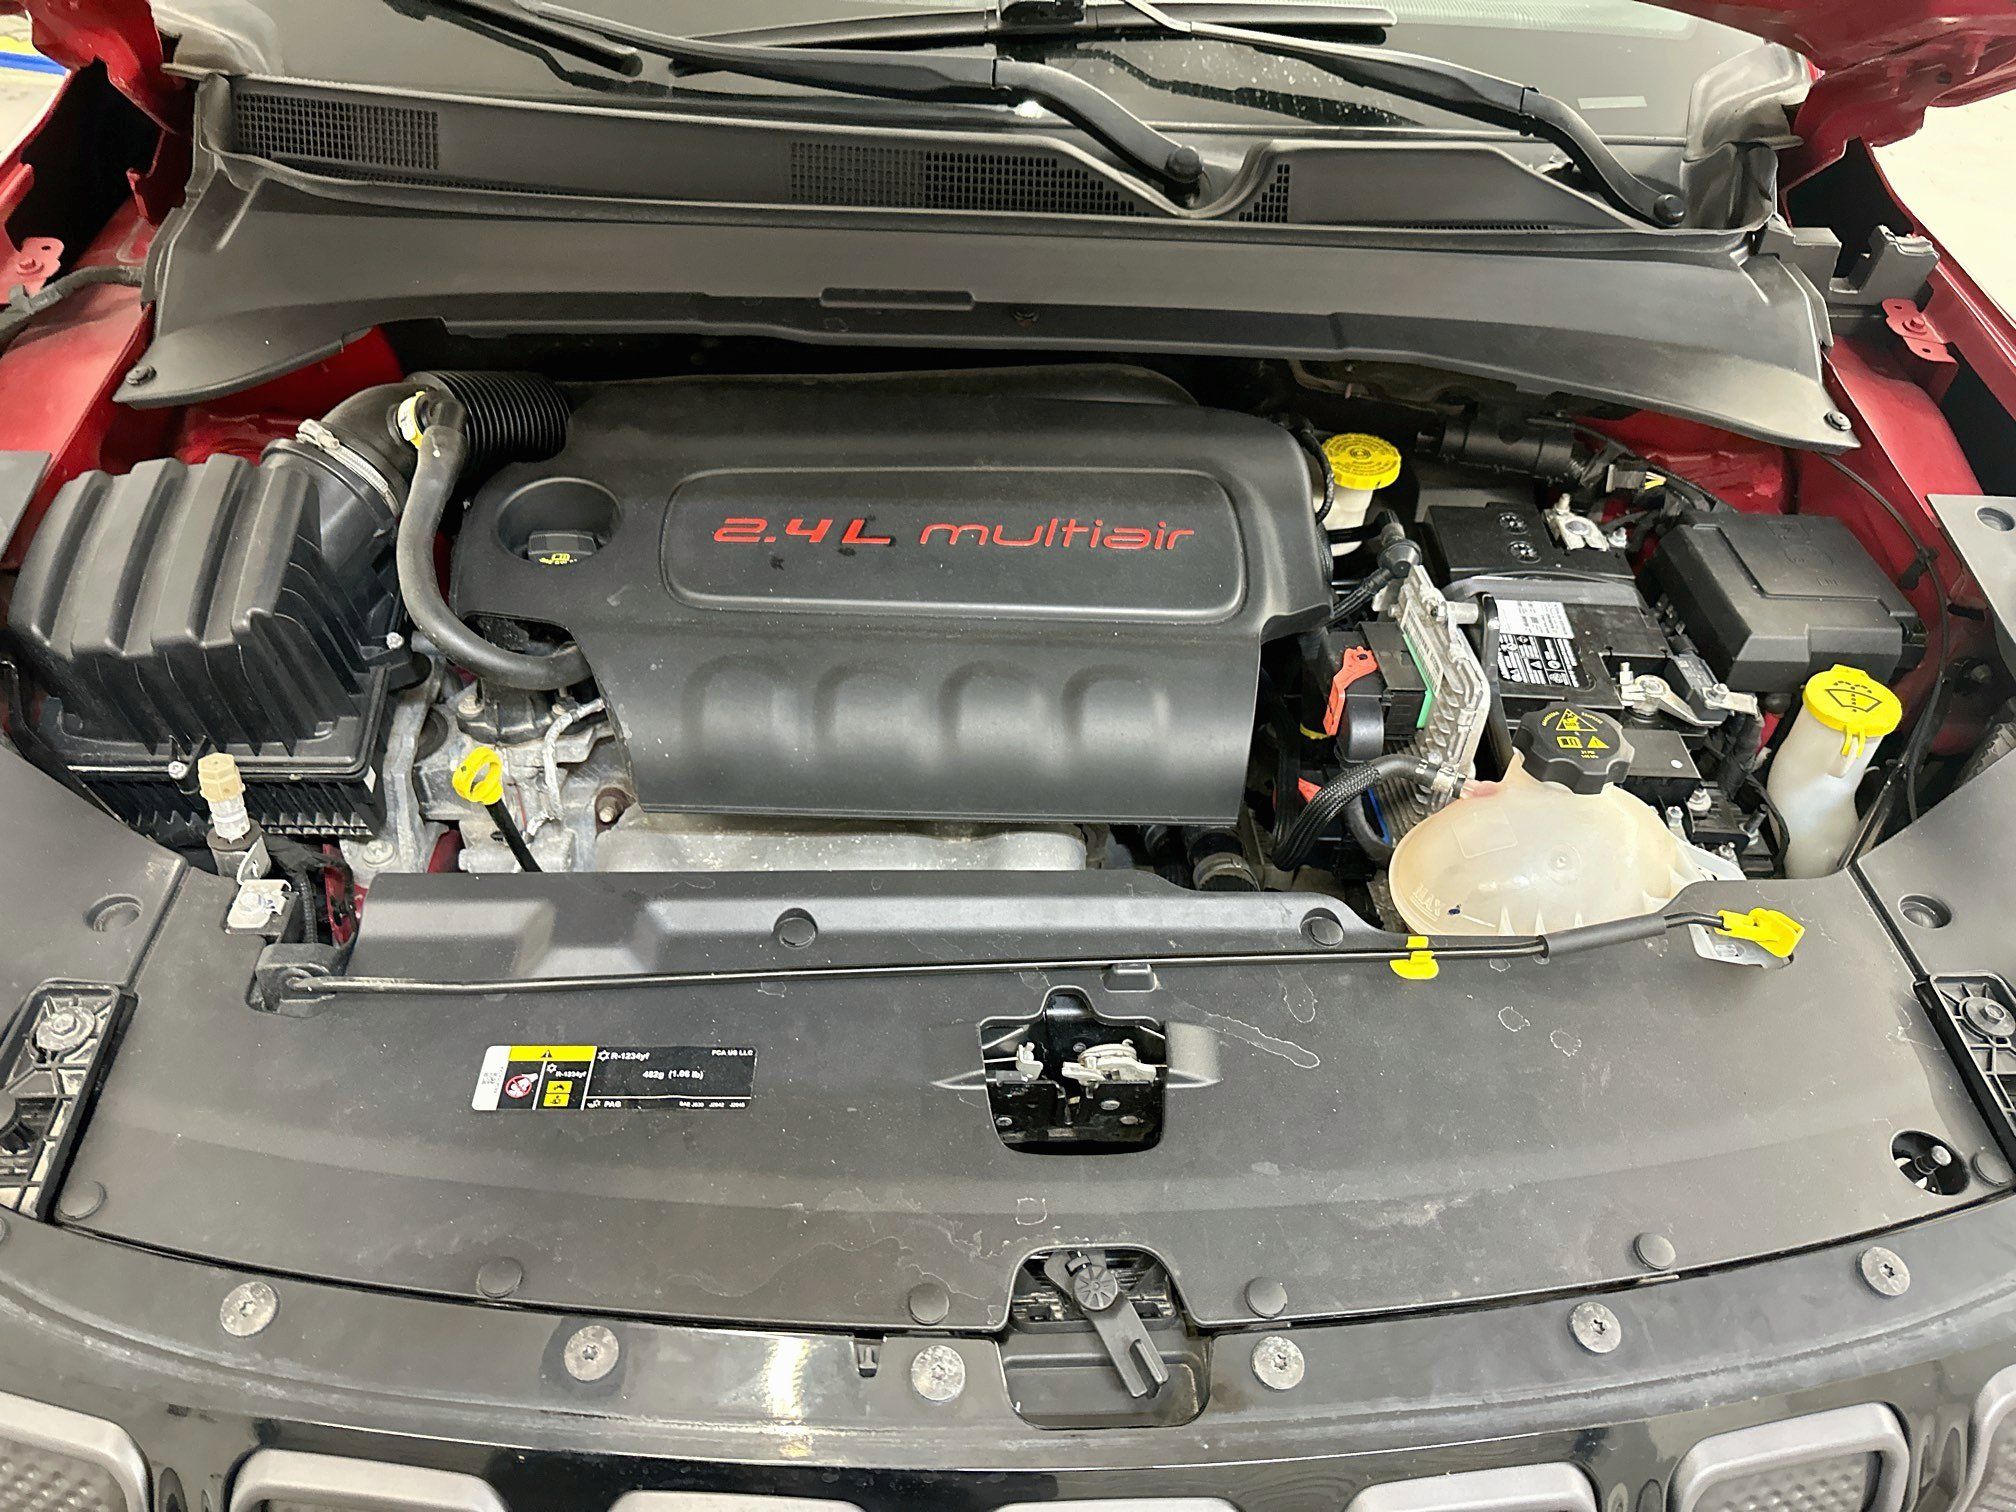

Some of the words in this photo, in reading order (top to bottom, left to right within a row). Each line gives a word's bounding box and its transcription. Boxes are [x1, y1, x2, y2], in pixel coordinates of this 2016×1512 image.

[920, 519, 1195, 550] multiair
[610, 1051, 650, 1062] R-1234yf
[604, 1100, 622, 1108] PAG
